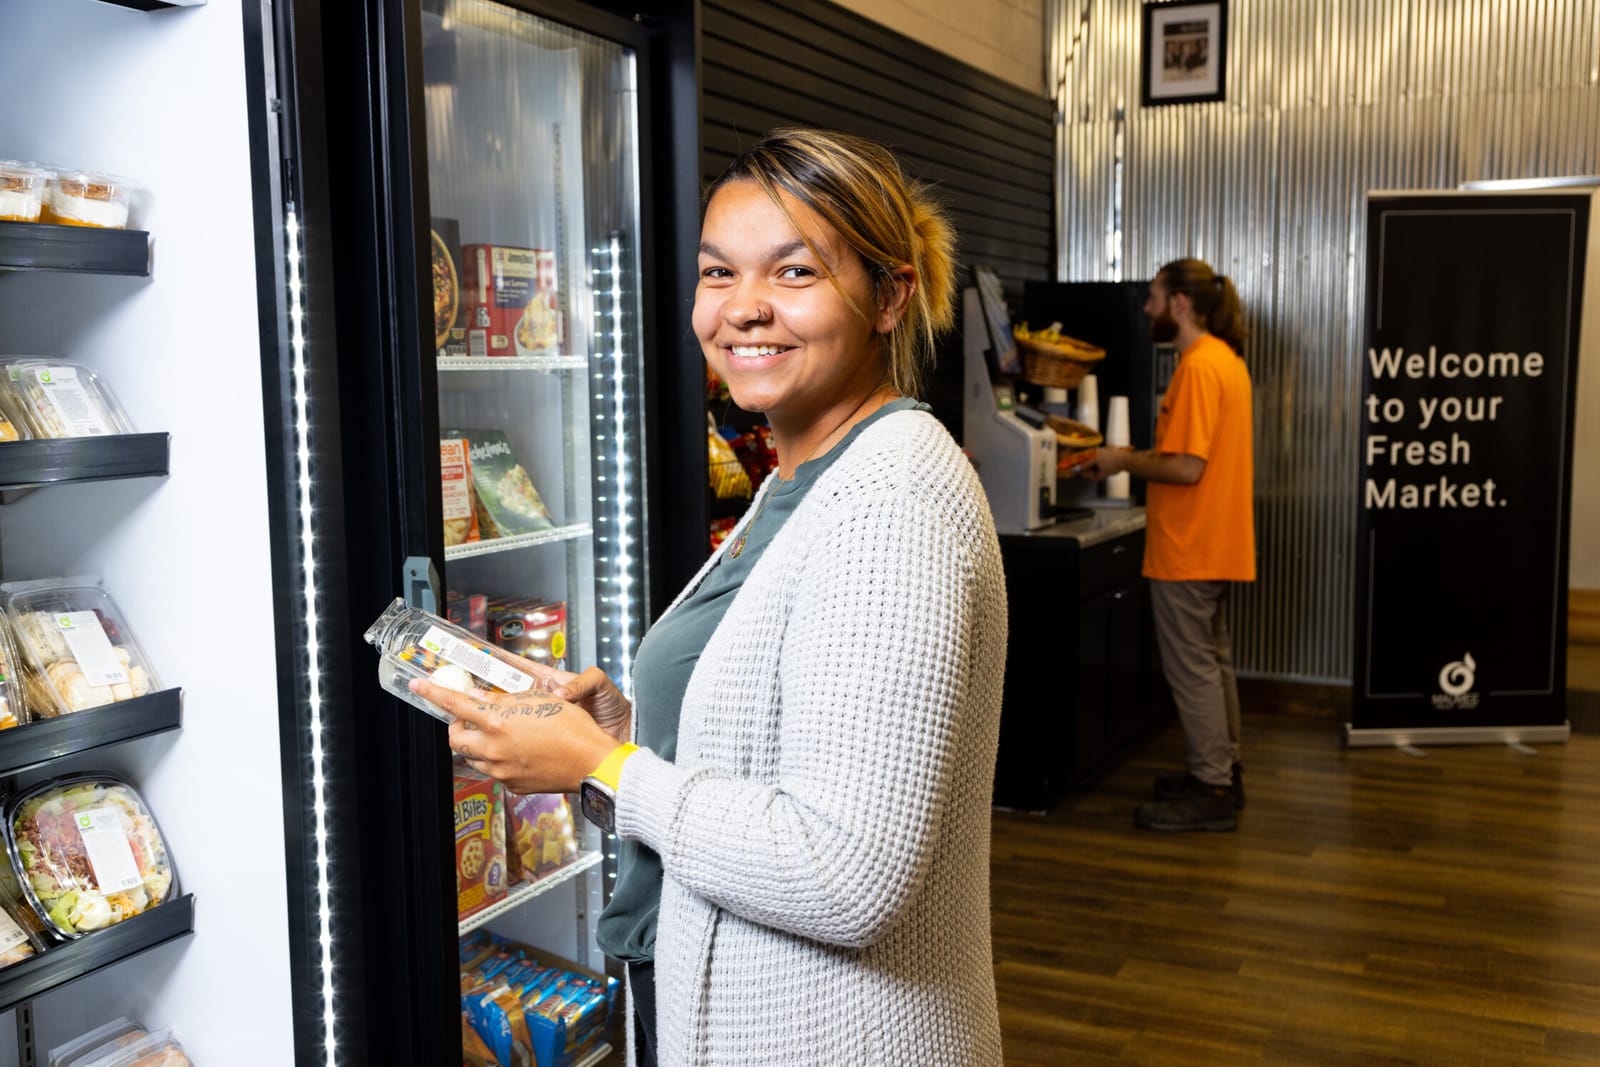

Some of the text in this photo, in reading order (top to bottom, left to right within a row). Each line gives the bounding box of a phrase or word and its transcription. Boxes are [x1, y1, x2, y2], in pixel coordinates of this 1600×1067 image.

[1368, 346, 1545, 379] Welcome
[1366, 393, 1503, 430] to your
[440, 444, 461, 456] ean
[1366, 432, 1471, 466] Fresh
[1365, 475, 1508, 510] Market.
[462, 799, 487, 821] Bites
